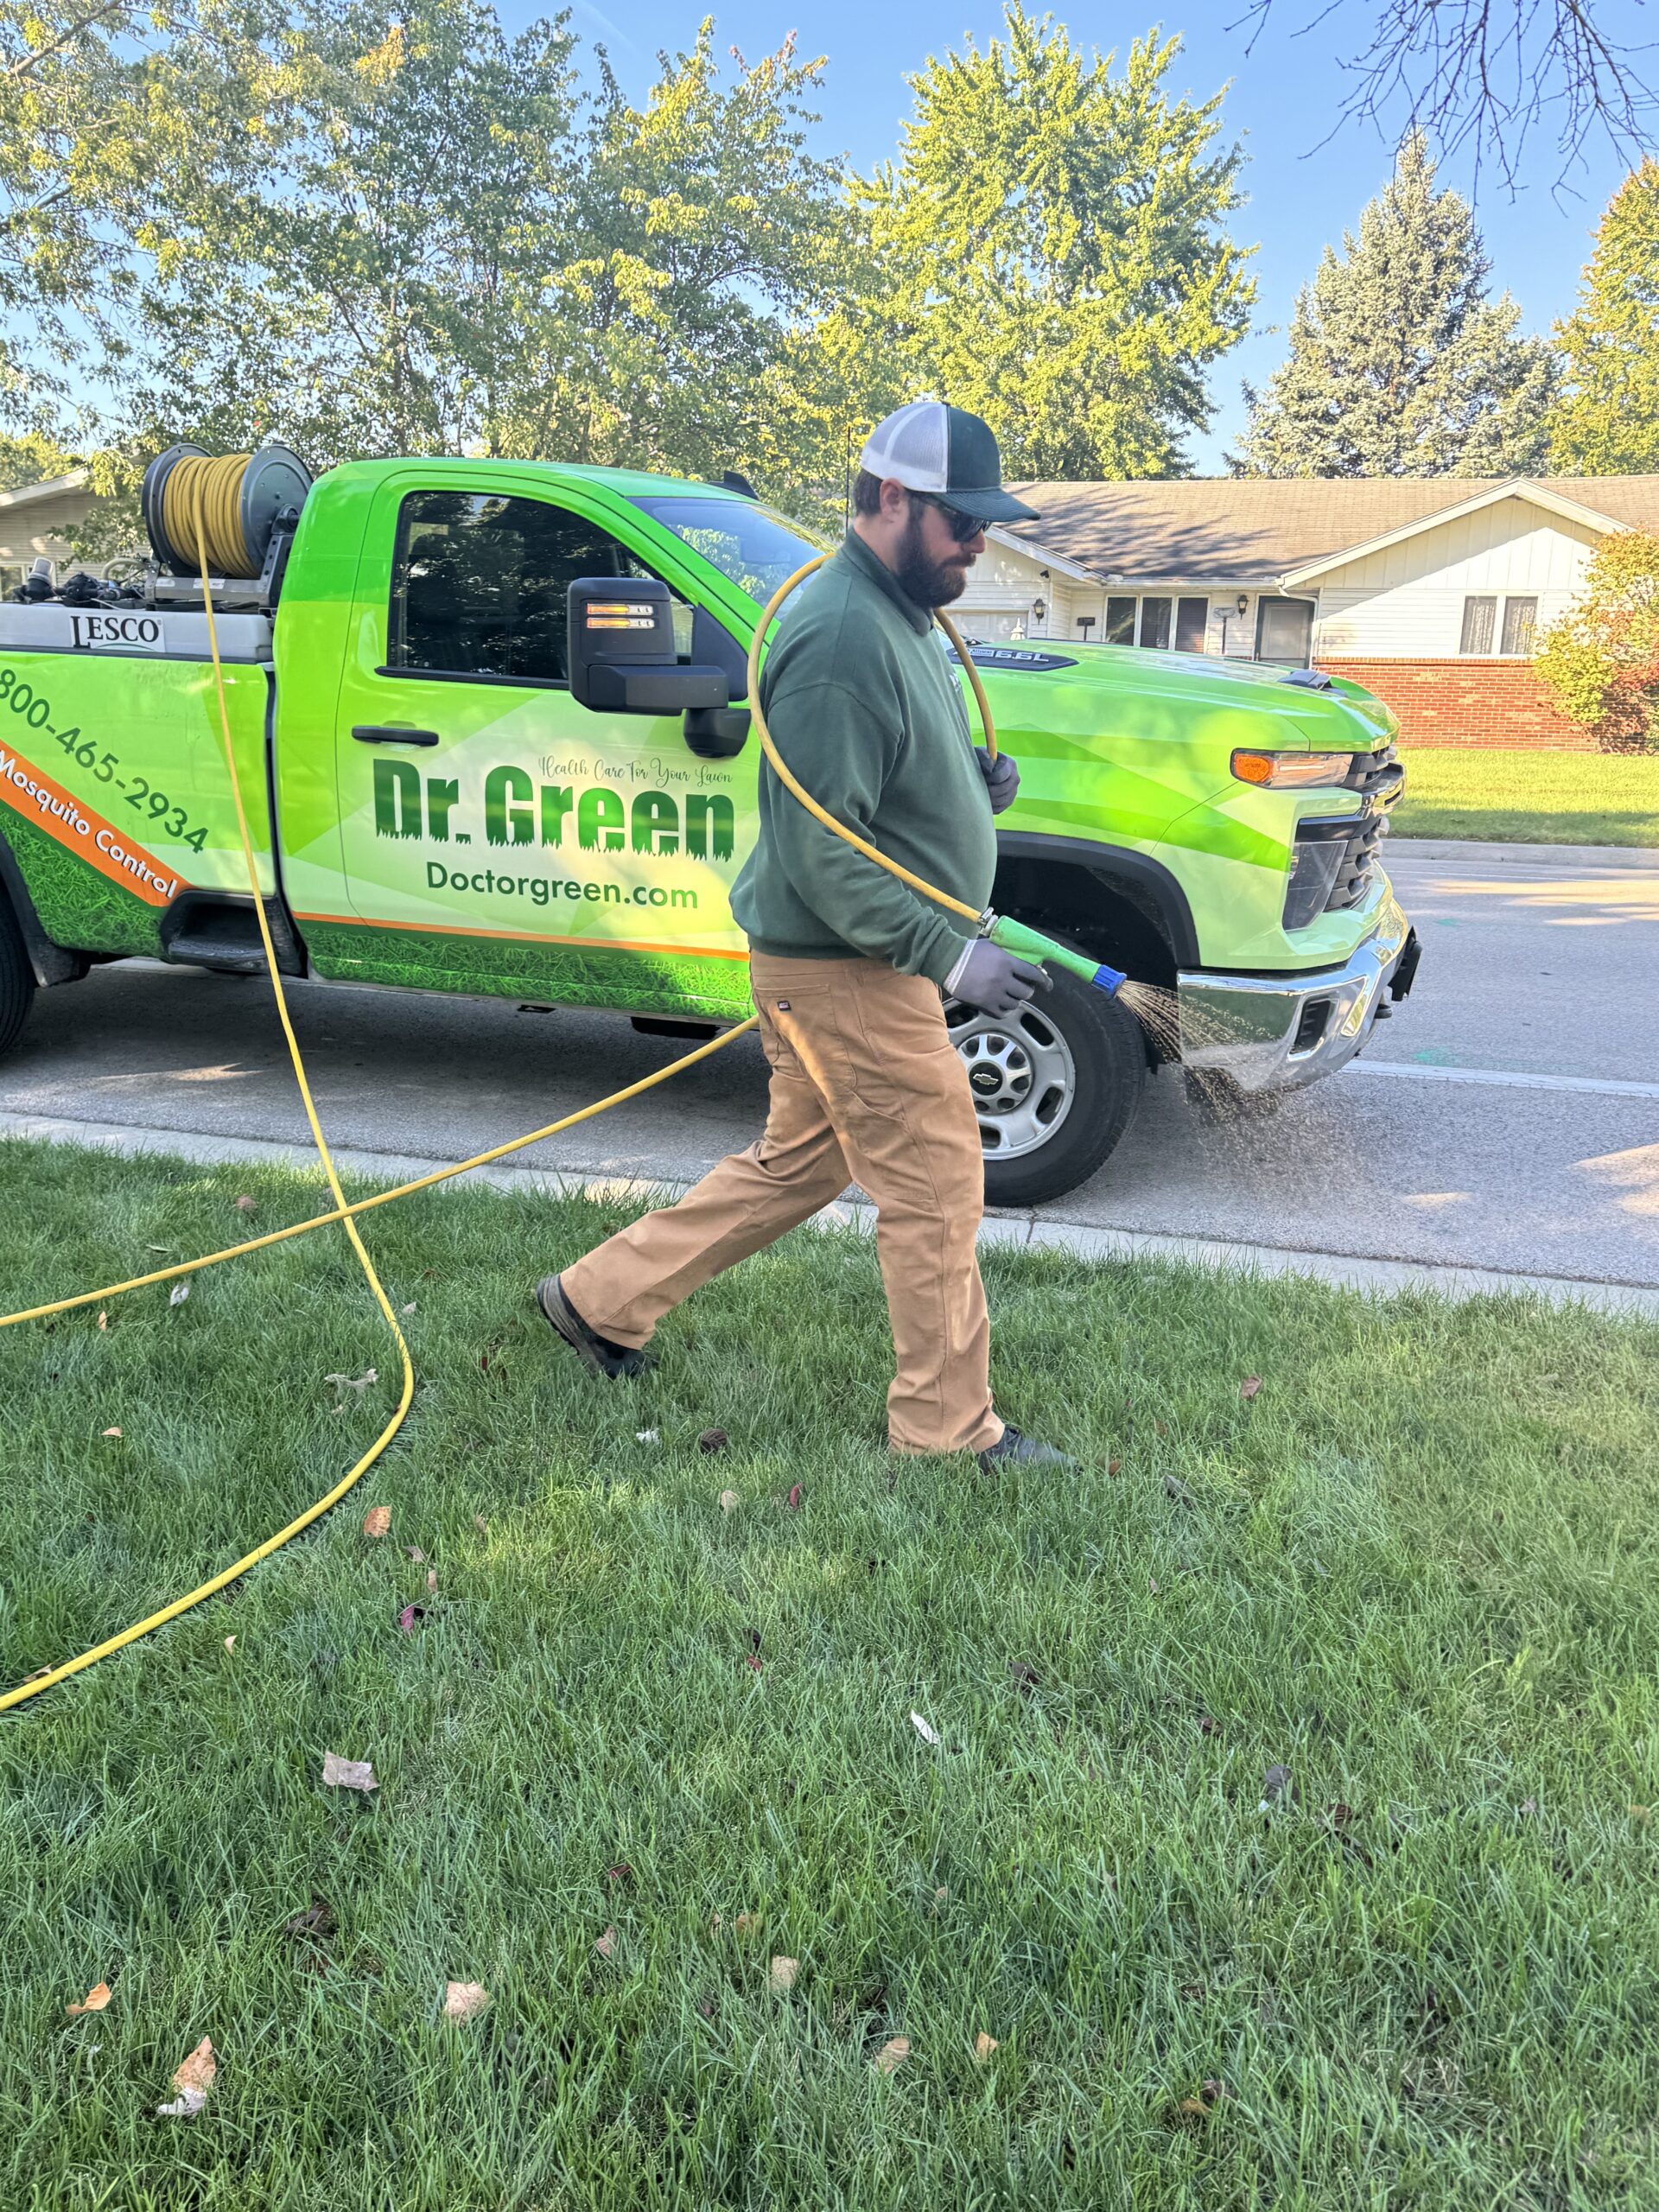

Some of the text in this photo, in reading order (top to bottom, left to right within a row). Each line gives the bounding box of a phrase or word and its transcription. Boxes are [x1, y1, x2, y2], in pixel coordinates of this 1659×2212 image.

[70, 615, 160, 649] LESCO
[995, 650, 1049, 662] 6.6L
[0, 669, 209, 855] 800-465-2934
[538, 754, 734, 788] Health Care For Your Lawn
[0, 749, 178, 899] Mosquito Control
[372, 757, 735, 863] Dr. Green
[426, 861, 699, 910] Doctorgreen.com
